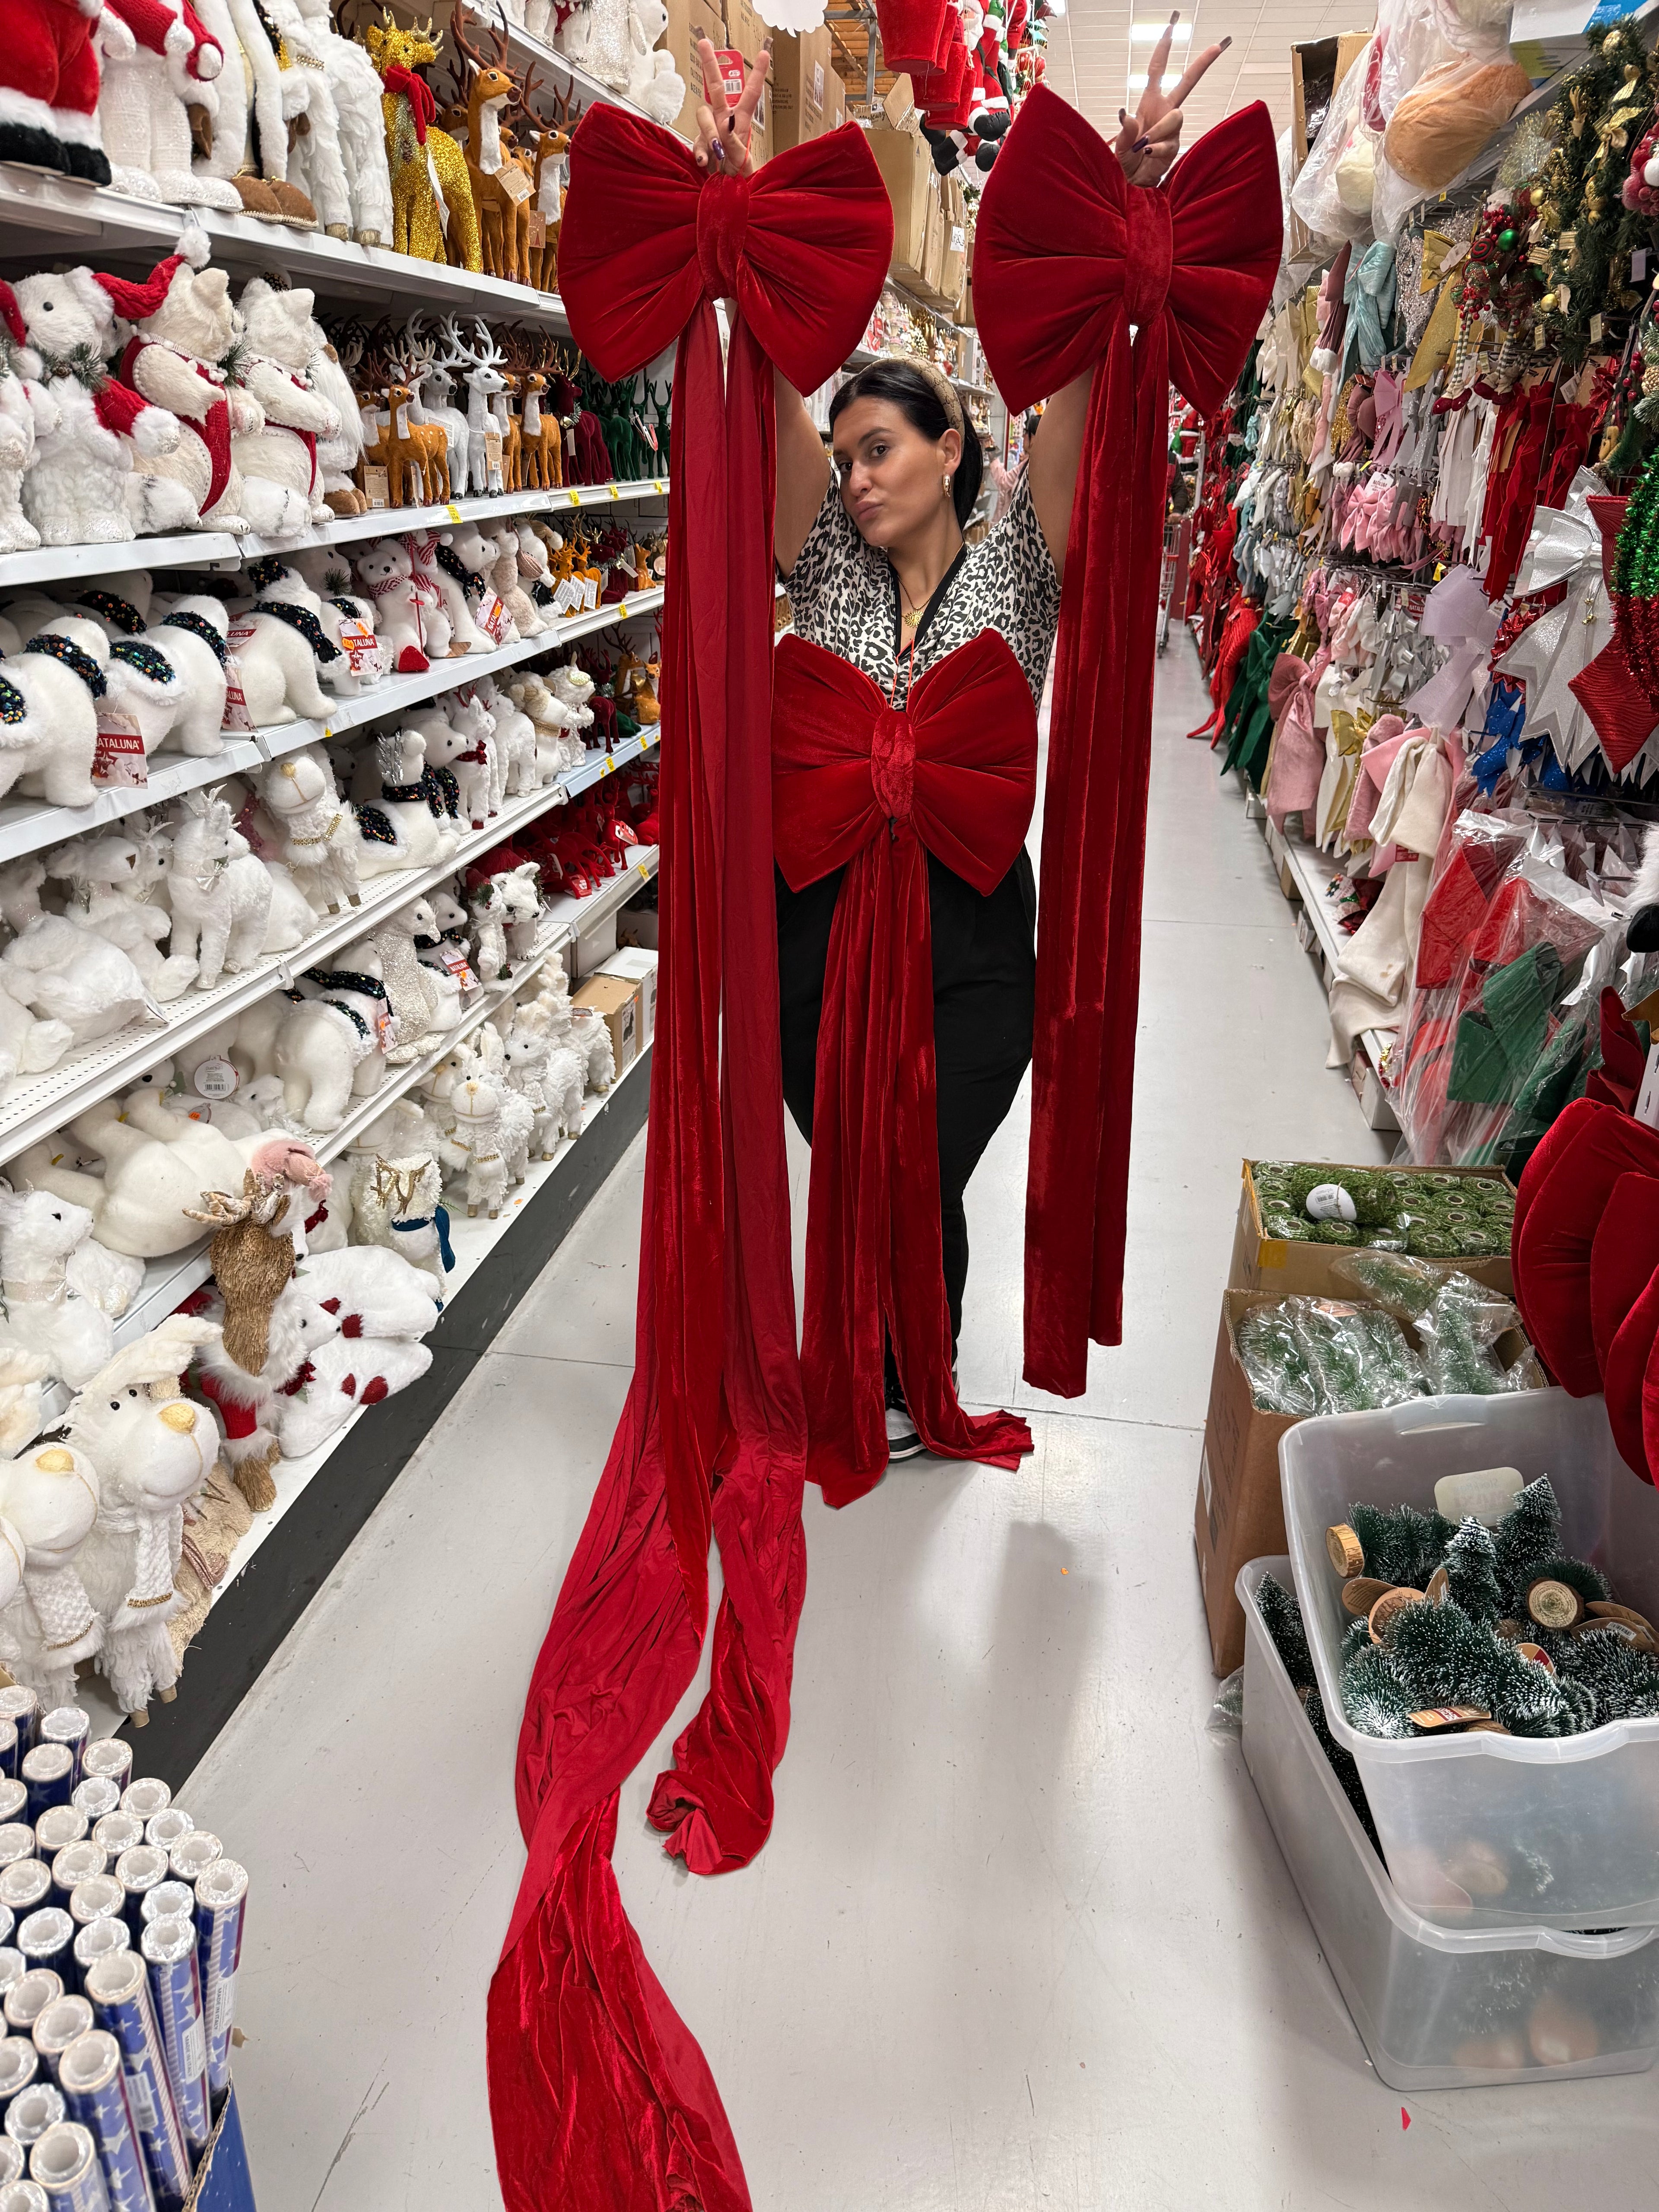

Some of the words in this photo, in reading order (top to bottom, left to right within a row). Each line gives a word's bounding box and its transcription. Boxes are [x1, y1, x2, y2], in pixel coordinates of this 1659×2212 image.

[488, 601, 502, 631] NATAA
[353, 638, 375, 647] TALUNA
[98, 737, 140, 750] ATALUNA
